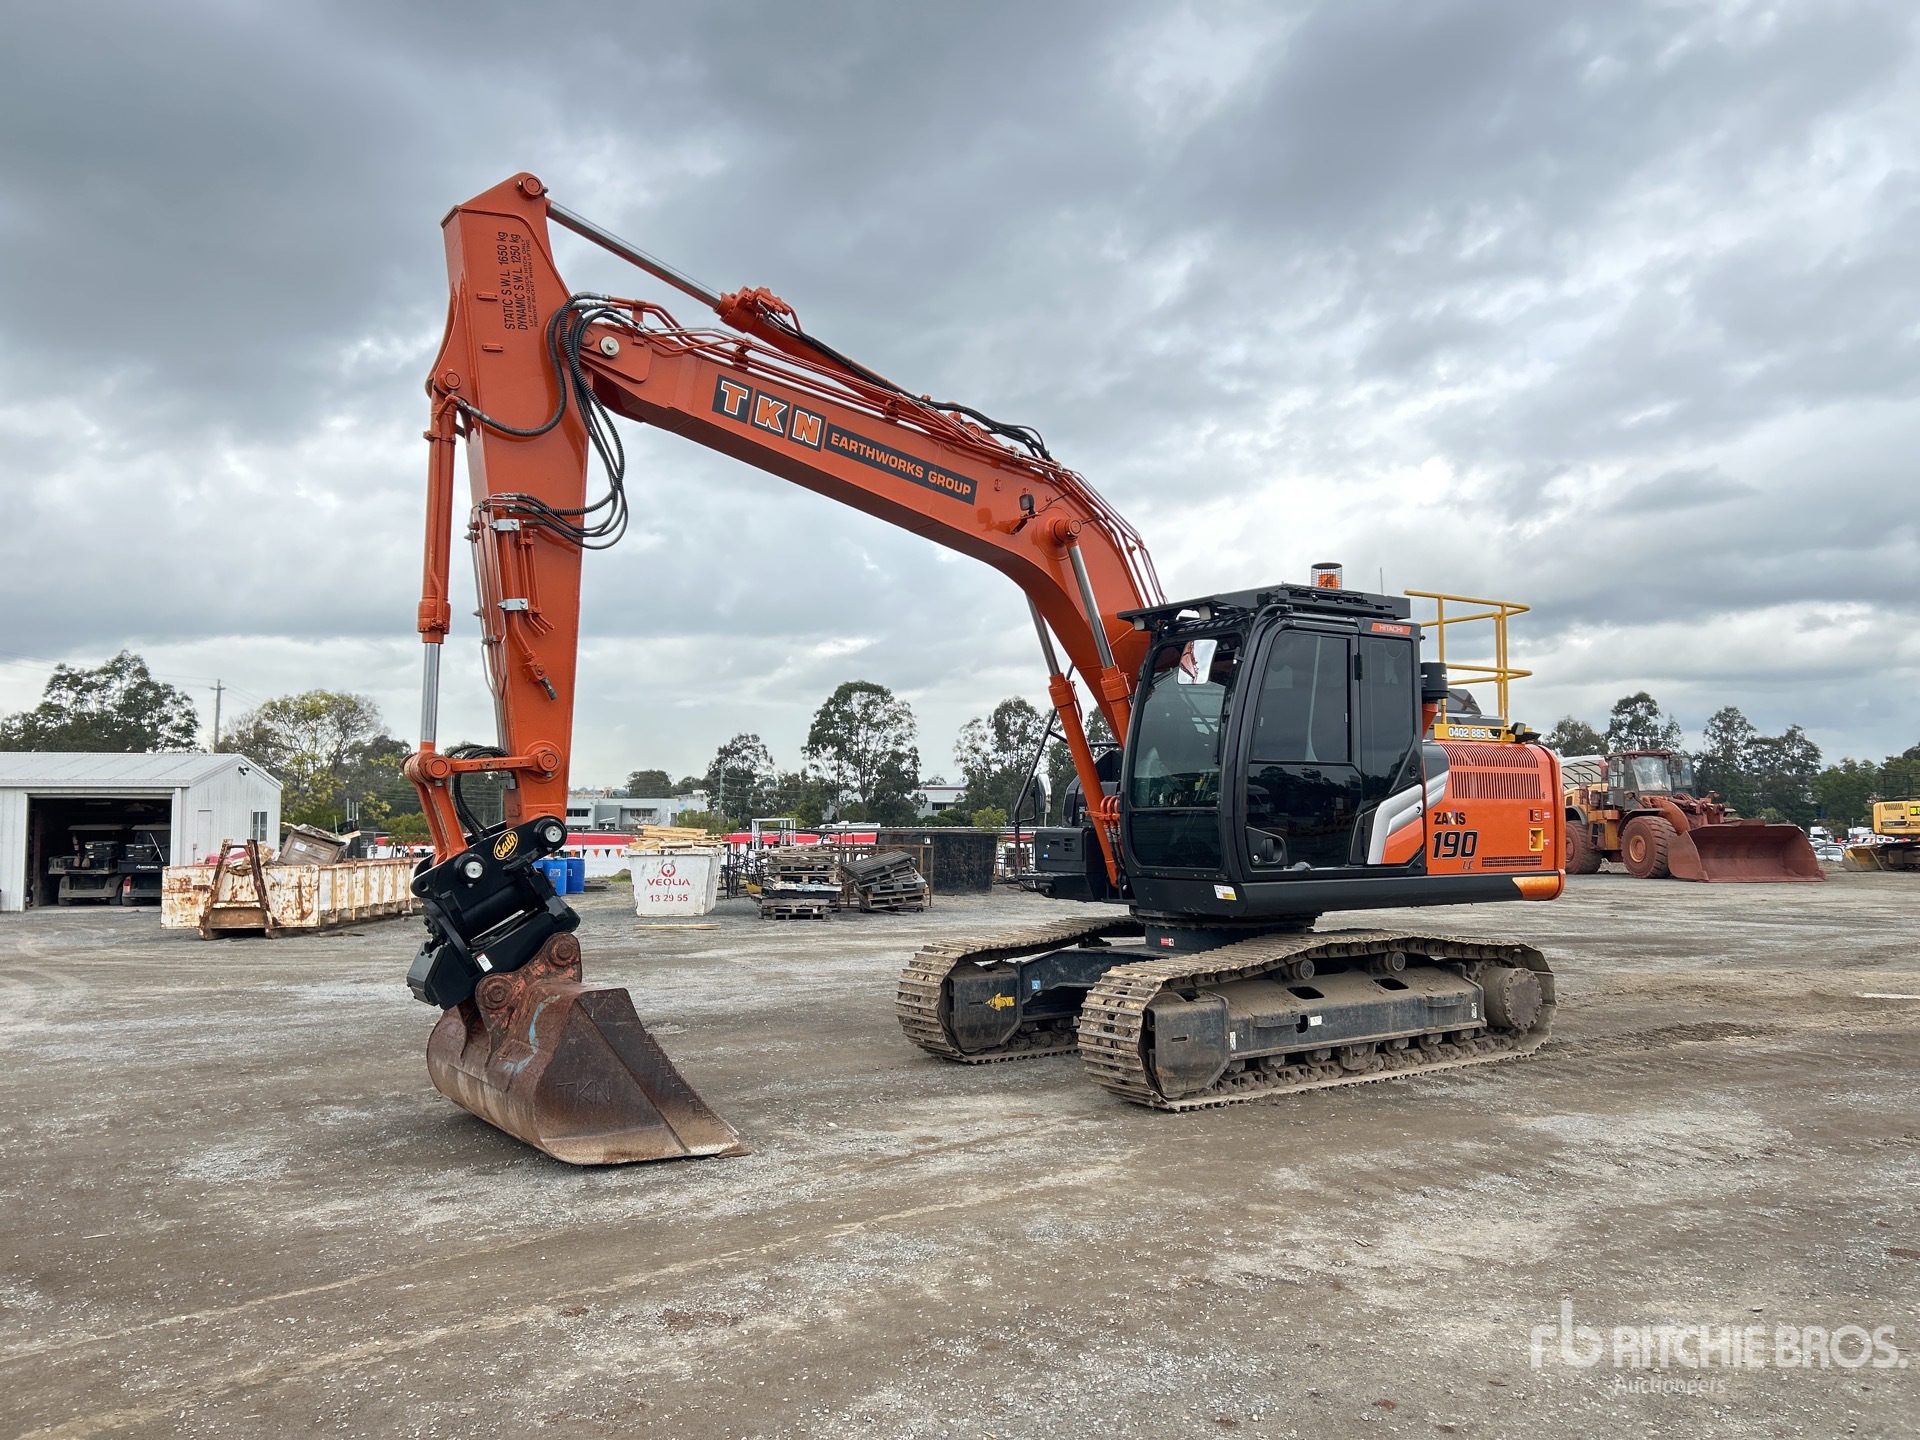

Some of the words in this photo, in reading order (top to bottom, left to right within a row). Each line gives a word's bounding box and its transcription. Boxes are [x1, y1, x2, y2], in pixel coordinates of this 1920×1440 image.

[496, 231, 508, 242] kg
[509, 233, 521, 243] kg
[497, 244, 509, 265] 1650
[510, 245, 521, 263] 1250
[500, 269, 512, 295] S.W.L.
[512, 266, 525, 291] S.W.L.
[502, 299, 516, 330] STATIC
[514, 293, 528, 330] DYNAMIC
[720, 380, 822, 447] TKN
[831, 433, 924, 479] EARTHWORKS
[928, 471, 971, 496] GROUP
[1379, 624, 1404, 633] HITACHI
[1448, 726, 1469, 738] 0402
[1471, 728, 1486, 739] 885
[1434, 810, 1466, 826] ZAXIS
[1432, 830, 1478, 859] 190
[1462, 861, 1475, 870] LC
[647, 878, 690, 886] VEOLIA
[677, 894, 688, 902] 55
